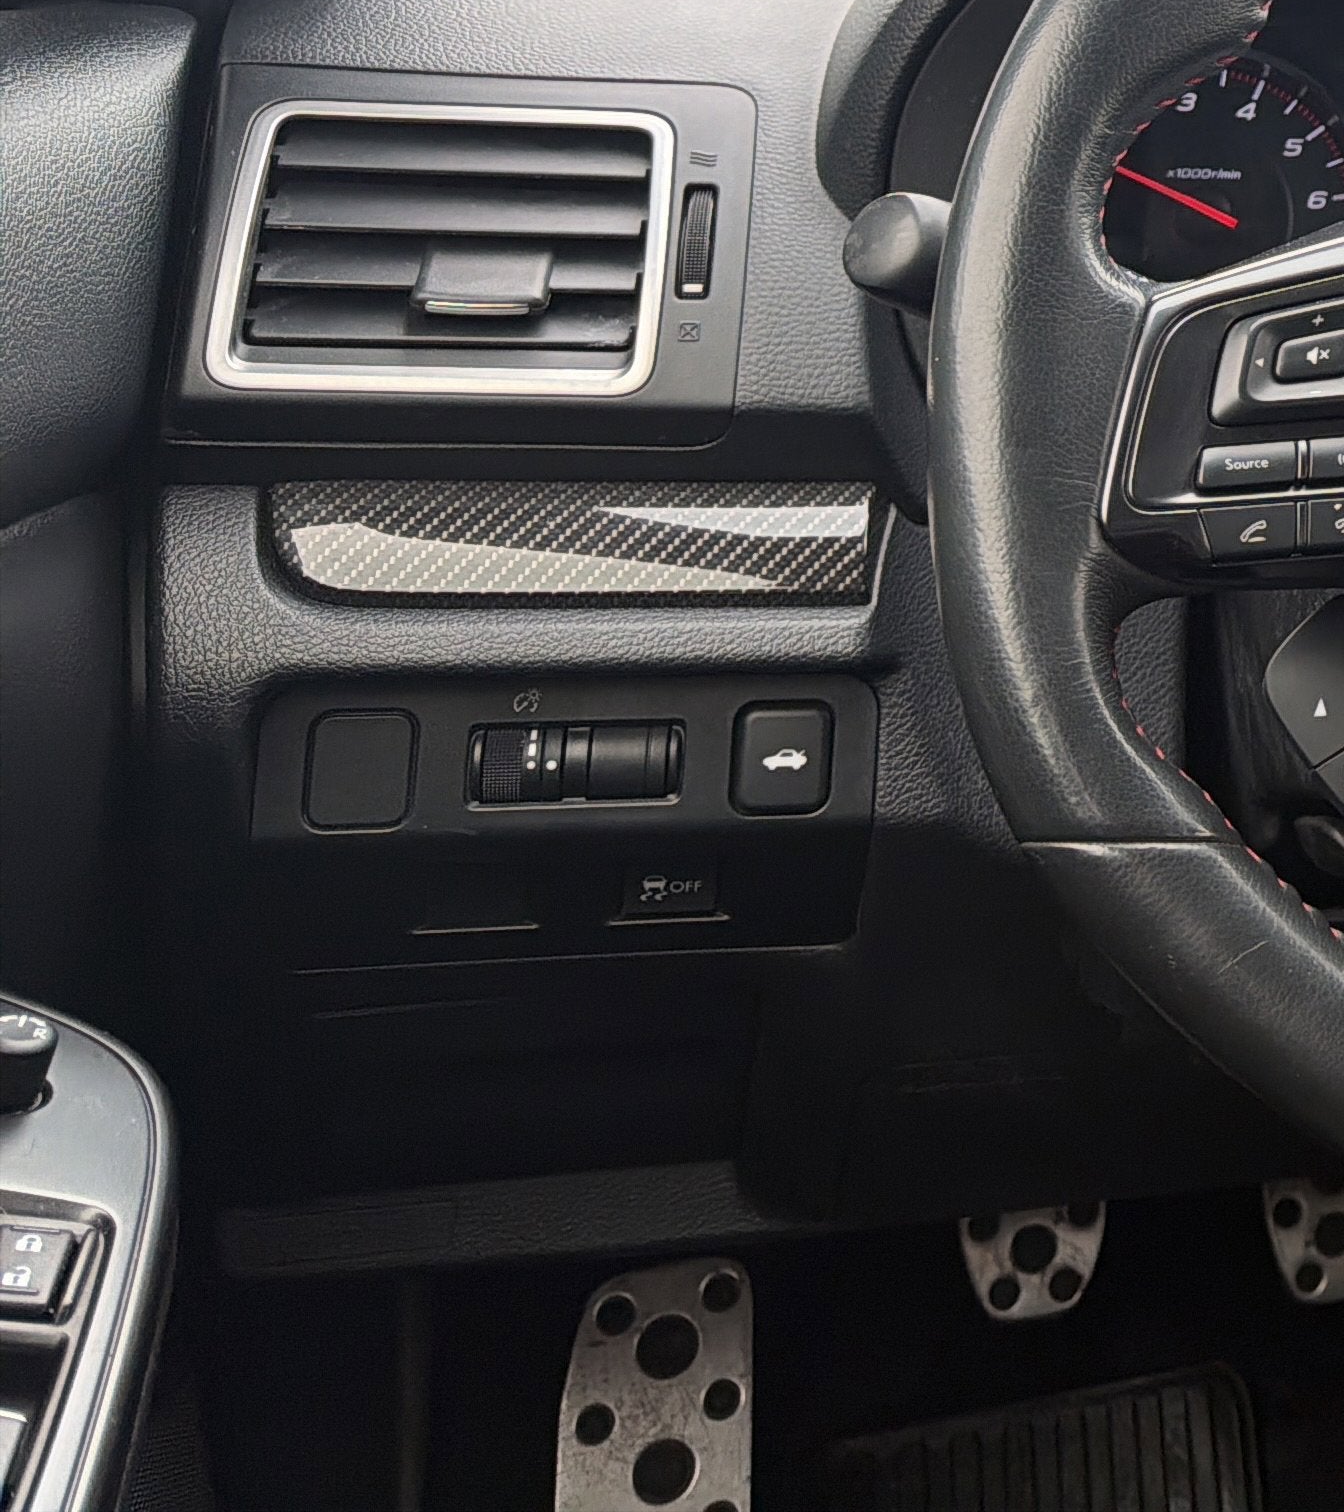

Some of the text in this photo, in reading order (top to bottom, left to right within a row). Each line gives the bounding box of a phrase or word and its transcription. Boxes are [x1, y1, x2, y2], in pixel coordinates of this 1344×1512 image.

[1176, 92, 1198, 113] 3
[1235, 101, 1257, 122] 4
[1283, 138, 1305, 157] 5
[1306, 190, 1329, 210] 6
[1224, 457, 1270, 472] Source
[669, 879, 703, 894] OFF
[33, 1027, 47, 1040] R
